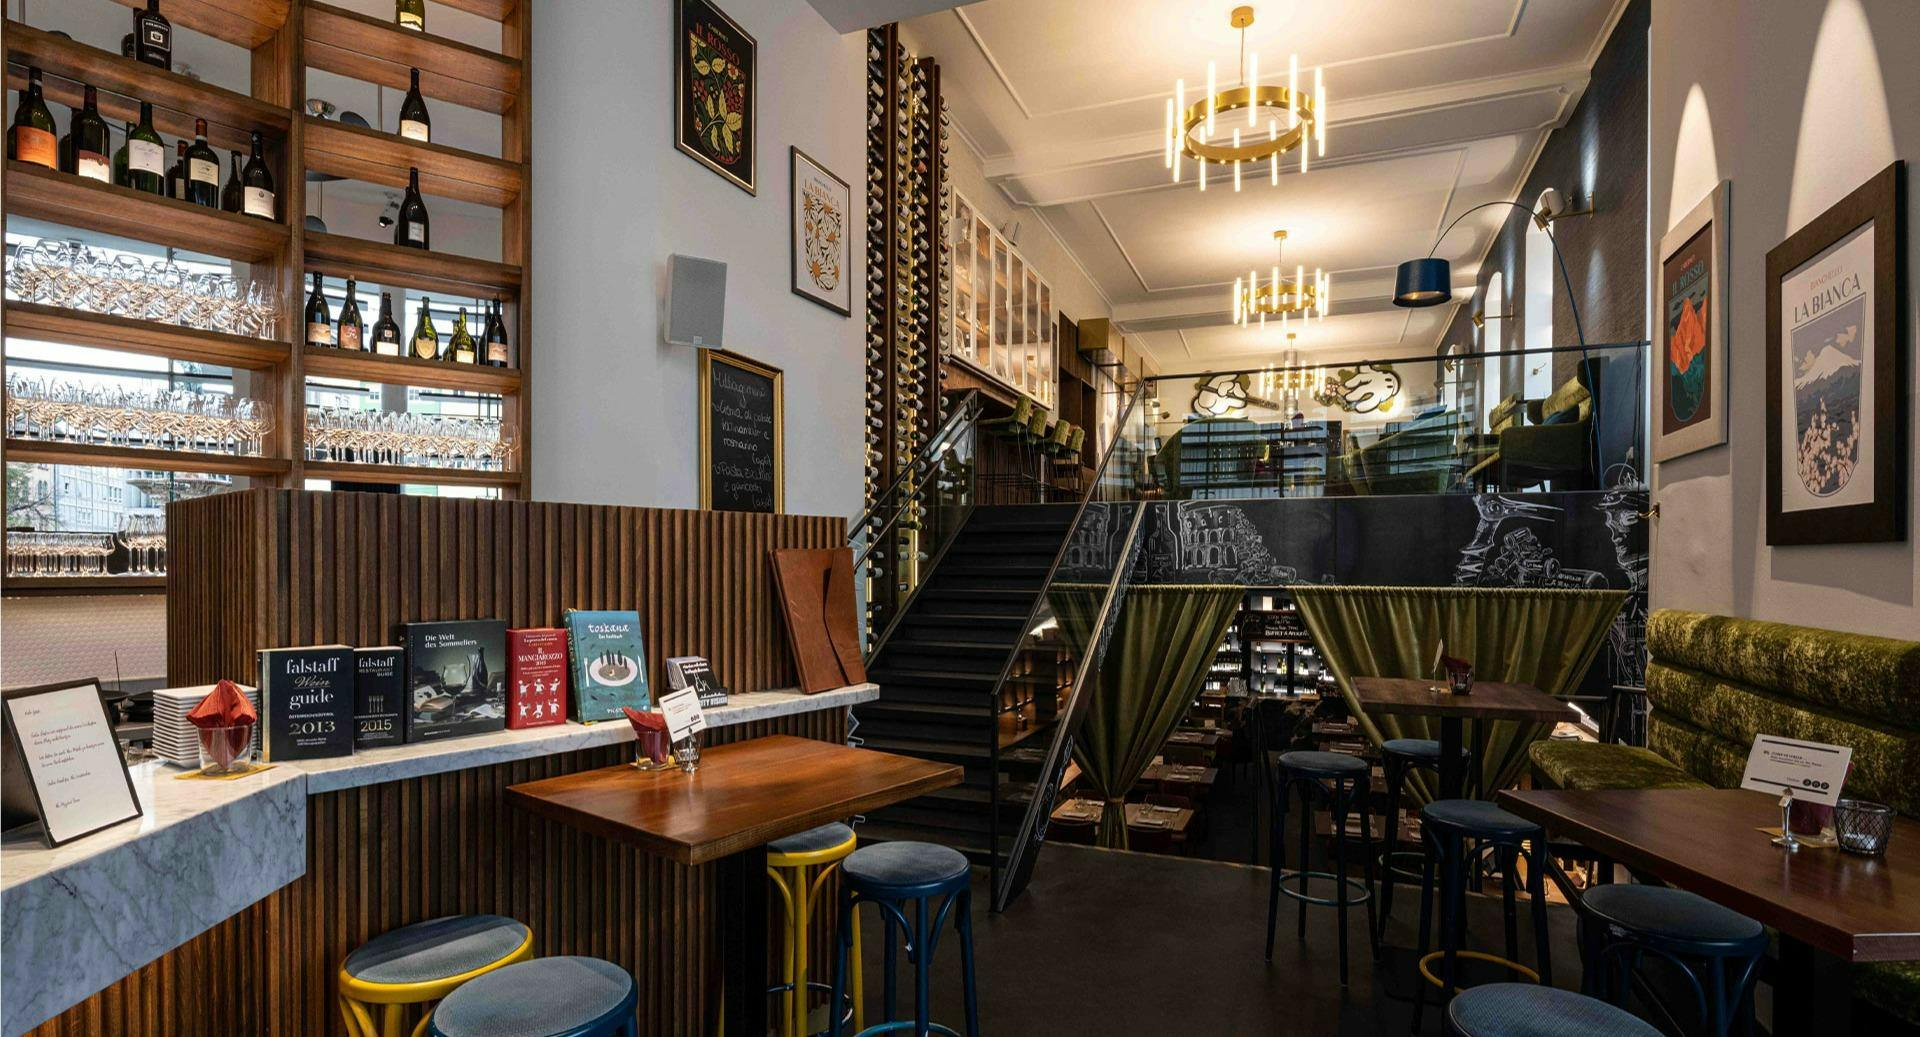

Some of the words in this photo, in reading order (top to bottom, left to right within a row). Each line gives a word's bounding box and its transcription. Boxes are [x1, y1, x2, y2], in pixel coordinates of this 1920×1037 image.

[706, 31, 740, 66] ROSSO
[815, 185, 840, 211] BIANCA
[1680, 259, 1704, 290] ROSSO
[1794, 301, 1810, 324] LA
[1812, 272, 1861, 315] BIANCA
[587, 623, 630, 633] toskana
[424, 641, 437, 649] des
[438, 639, 478, 648] Sommeliers
[425, 634, 437, 642] Die
[438, 633, 455, 641] Welt
[285, 656, 341, 674] falstaff
[359, 656, 396, 668] falstaff
[294, 675, 330, 689] Wein
[289, 688, 334, 710] guide
[288, 721, 336, 736] 2013
[360, 718, 392, 732] 2015
